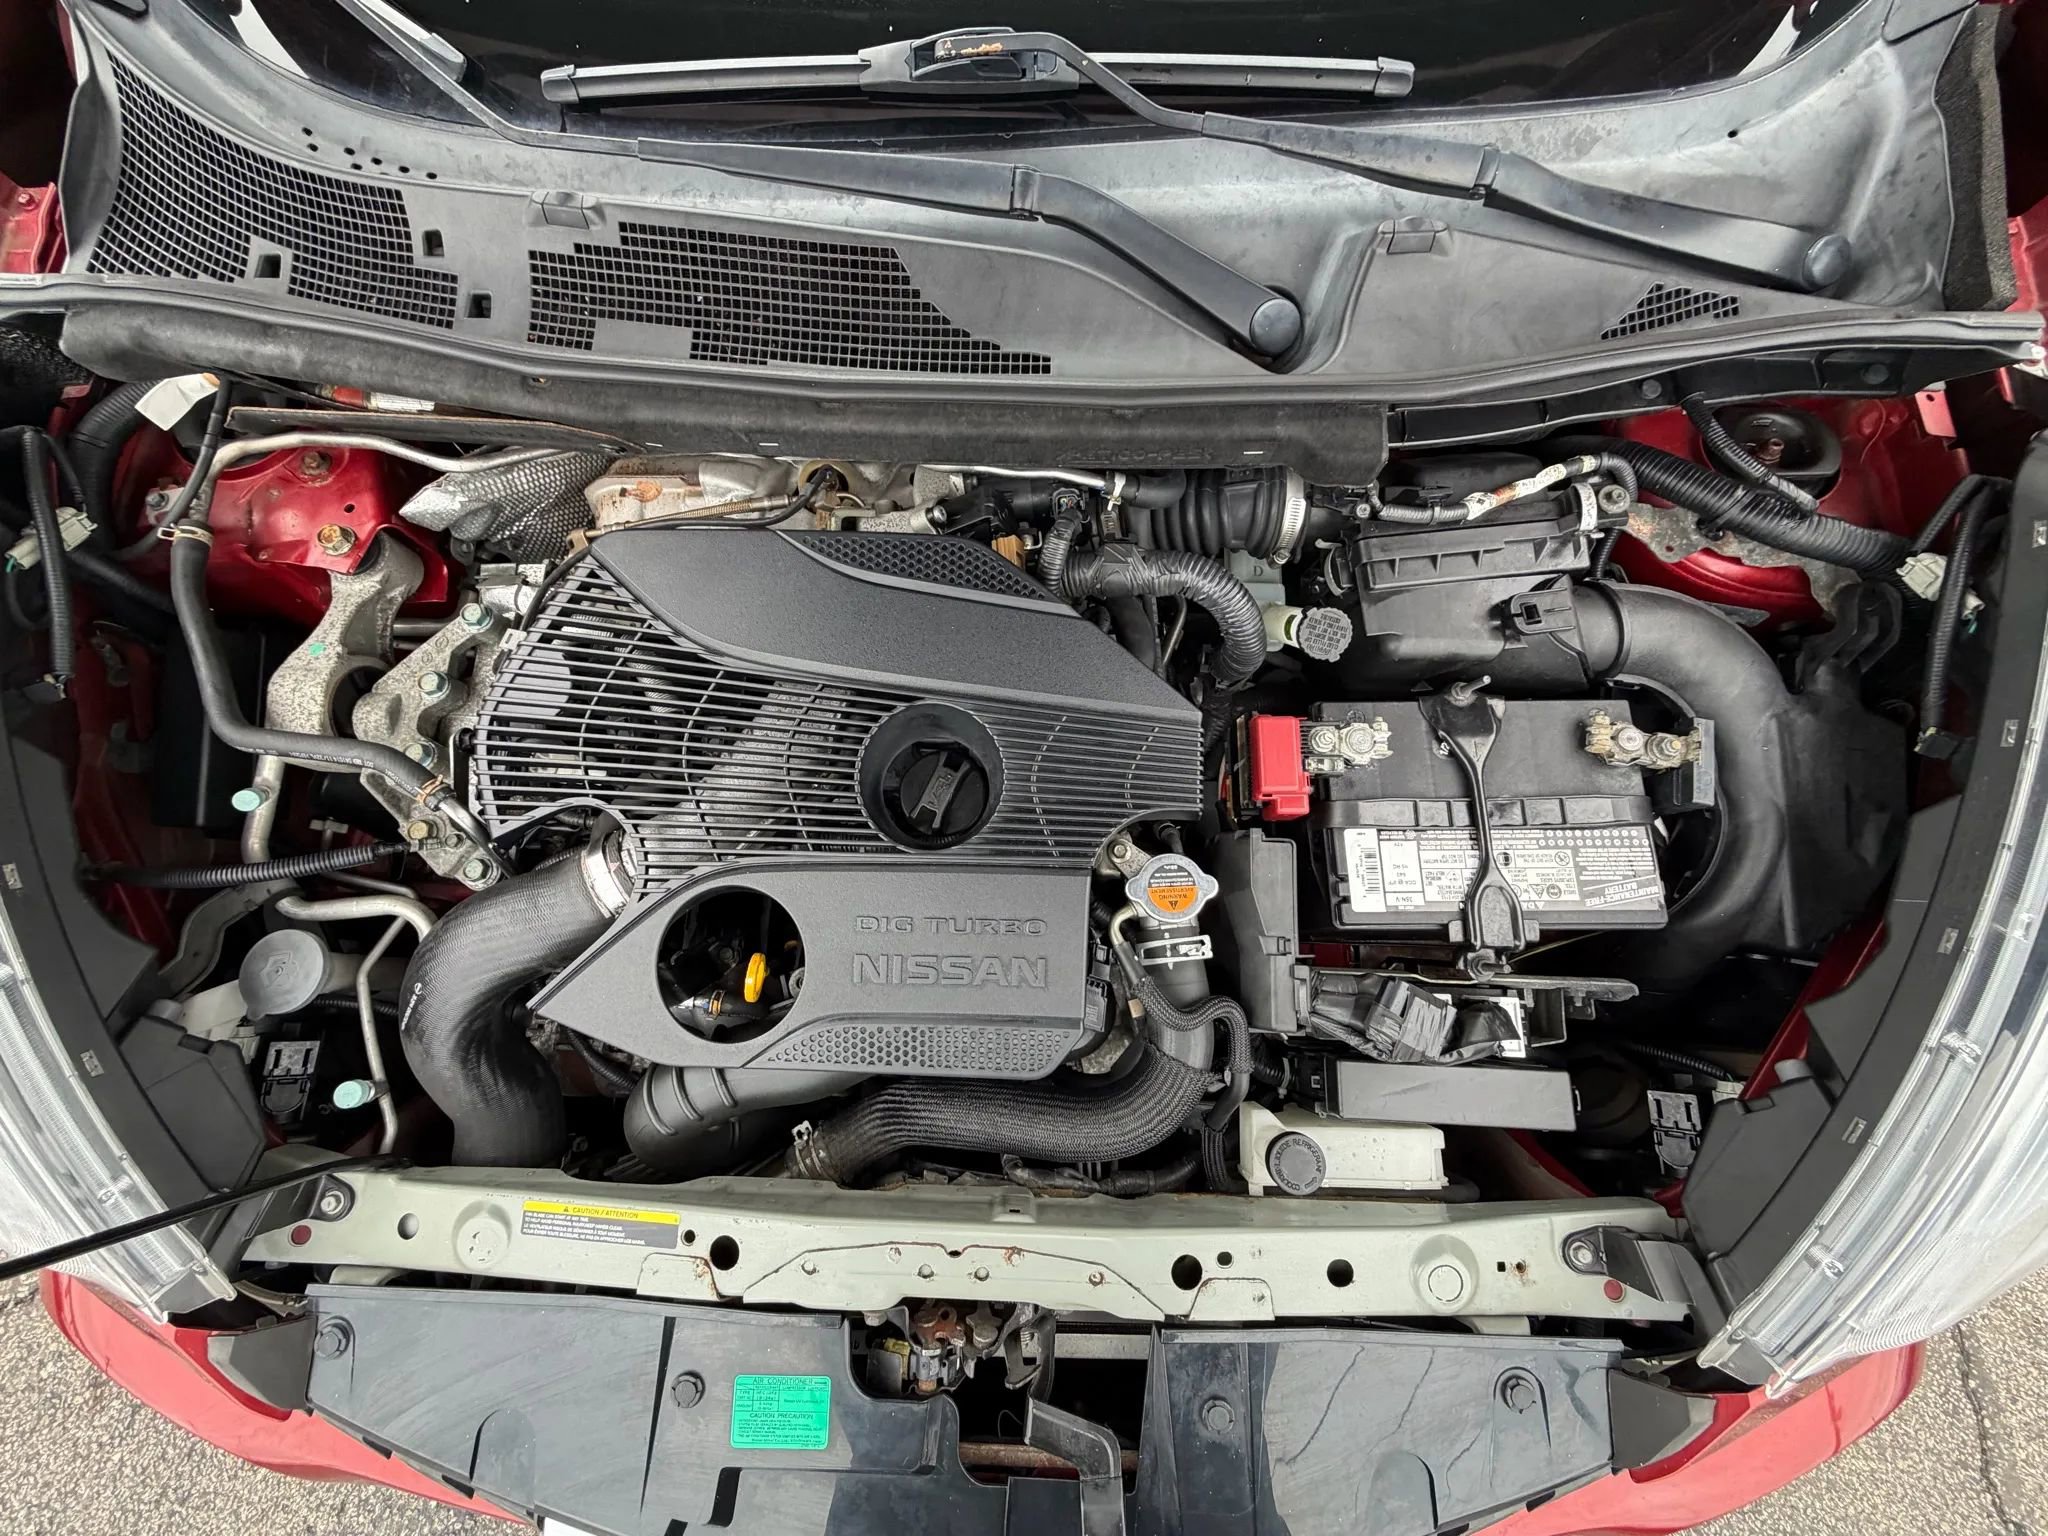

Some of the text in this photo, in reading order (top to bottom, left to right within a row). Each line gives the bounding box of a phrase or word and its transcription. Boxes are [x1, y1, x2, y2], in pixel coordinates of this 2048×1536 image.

[1604, 882, 1638, 895] BATTERY
[855, 915, 1049, 937] DIG TURBO
[853, 952, 1048, 989] NISSAN
[572, 1206, 600, 1216] CAUTION
[605, 1209, 639, 1219] ATTENTION
[753, 1376, 814, 1385] AIR CONDITIONER
